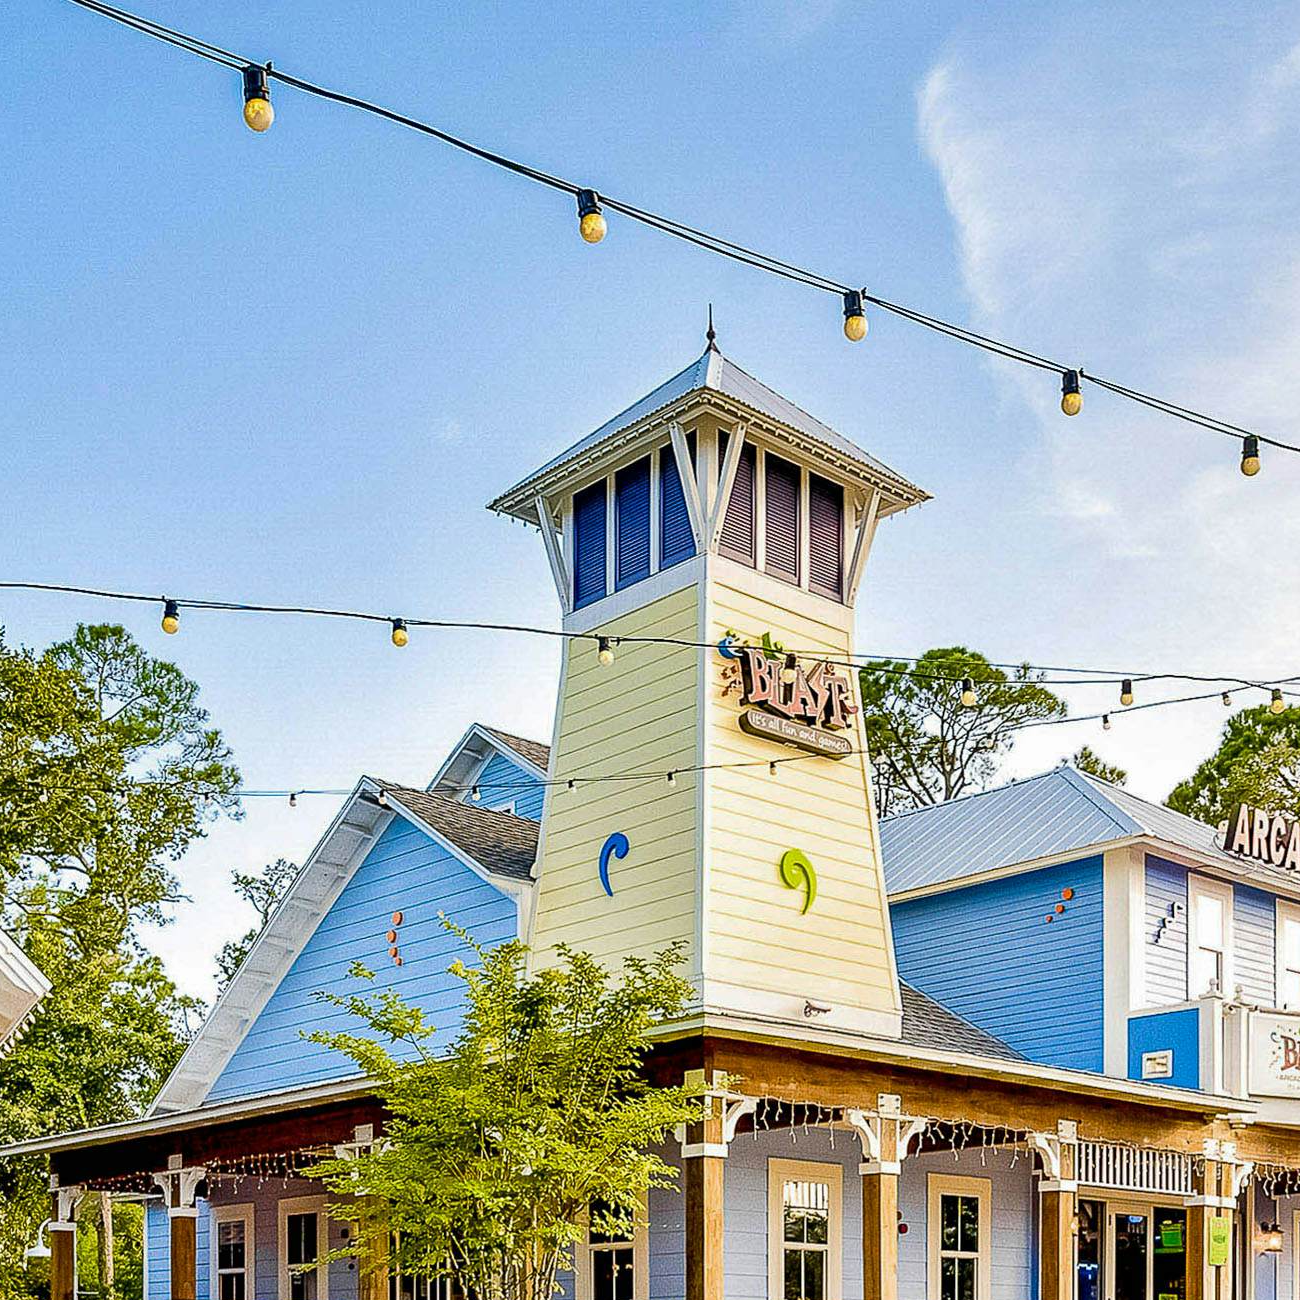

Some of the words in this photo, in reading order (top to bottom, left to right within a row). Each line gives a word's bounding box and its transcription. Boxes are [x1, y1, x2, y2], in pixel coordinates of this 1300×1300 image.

[746, 648, 850, 728] BLAST
[768, 718, 780, 730] all
[782, 722, 797, 736] fun
[799, 730, 816, 742] and
